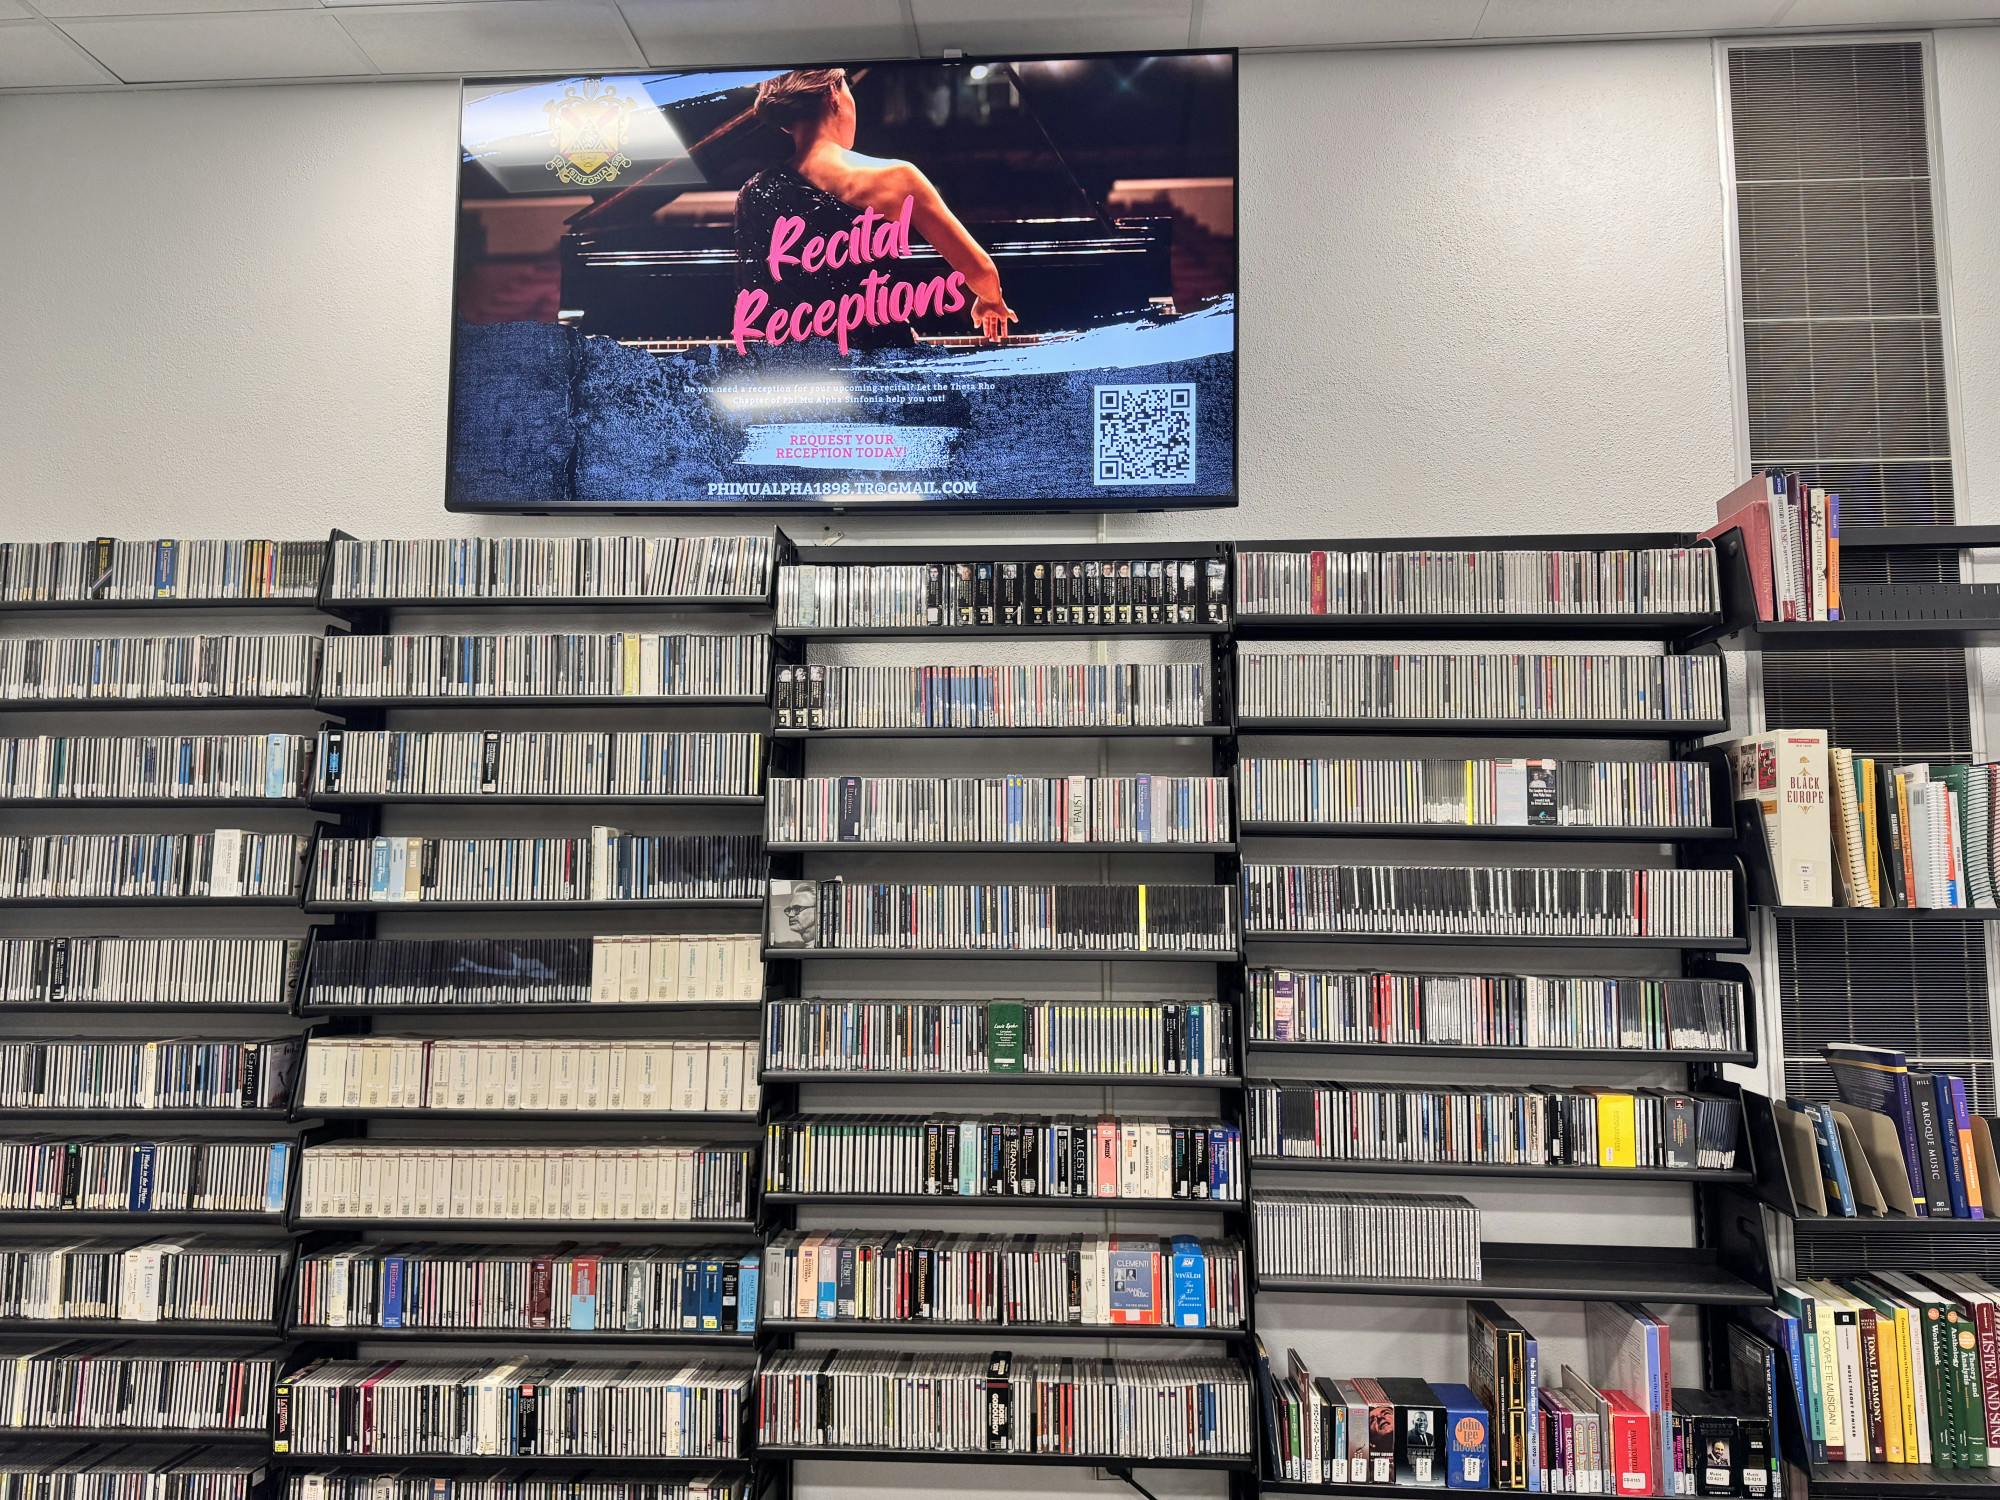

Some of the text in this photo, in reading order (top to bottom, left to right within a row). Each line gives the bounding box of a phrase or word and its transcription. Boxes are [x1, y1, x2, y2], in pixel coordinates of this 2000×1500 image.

[569, 168, 609, 184] SINFONIA
[767, 195, 915, 282] Recital
[730, 269, 966, 357] Receptions
[698, 387, 716, 395] you
[716, 385, 738, 393] need
[748, 385, 791, 394] reception
[794, 384, 806, 393] for
[834, 384, 878, 394] upcoming
[880, 383, 915, 392] recital?
[917, 383, 932, 391] Let
[933, 383, 948, 391] the
[950, 383, 976, 391] Theta
[978, 382, 996, 390] Rho
[816, 396, 842, 405] Alpha
[844, 395, 884, 404] Sinfonia
[885, 395, 906, 405] help
[908, 396, 925, 405] you
[926, 395, 946, 403] out!
[776, 446, 907, 459] RECEPTION TODAY!
[790, 434, 894, 447] REQUEST YOUR
[707, 481, 978, 496] PHIMUALPHA1898.TR@GMAIL.COM
[1814, 529, 1826, 599] Capturing Music
[1786, 790, 1824, 804] EUROPE
[1790, 776, 1820, 790] BLACK
[1072, 793, 1083, 824] FAUST
[247, 1052, 256, 1095] Capriccio
[1921, 1101, 1941, 1180] BAROQUE MUSIC
[1946, 1118, 1955, 1137] Music
[1952, 1156, 1962, 1182] Baroque
[1076, 1137, 1086, 1181] ALCESTE
[1116, 1259, 1149, 1268] CLEMENTI
[1866, 1333, 1877, 1368] TONAL
[1931, 1324, 1942, 1366] Workbook
[1950, 1327, 1960, 1368] Anthology
[1981, 1332, 1994, 1379] LISTEN
[1822, 1336, 1837, 1426] COMPLETE MUSICIAN
[1960, 1350, 1971, 1385] Analysis
[1968, 1350, 1980, 1398] Theory and
[1870, 1369, 1882, 1423] HARMONY
[1986, 1380, 1998, 1411] AND
[991, 1393, 999, 1435] GODOUNOV
[1458, 1419, 1480, 1432] John
[1989, 1412, 2000, 1445] SING
[1453, 1441, 1487, 1453] Hooker
[1463, 1431, 1479, 1441] Lee
